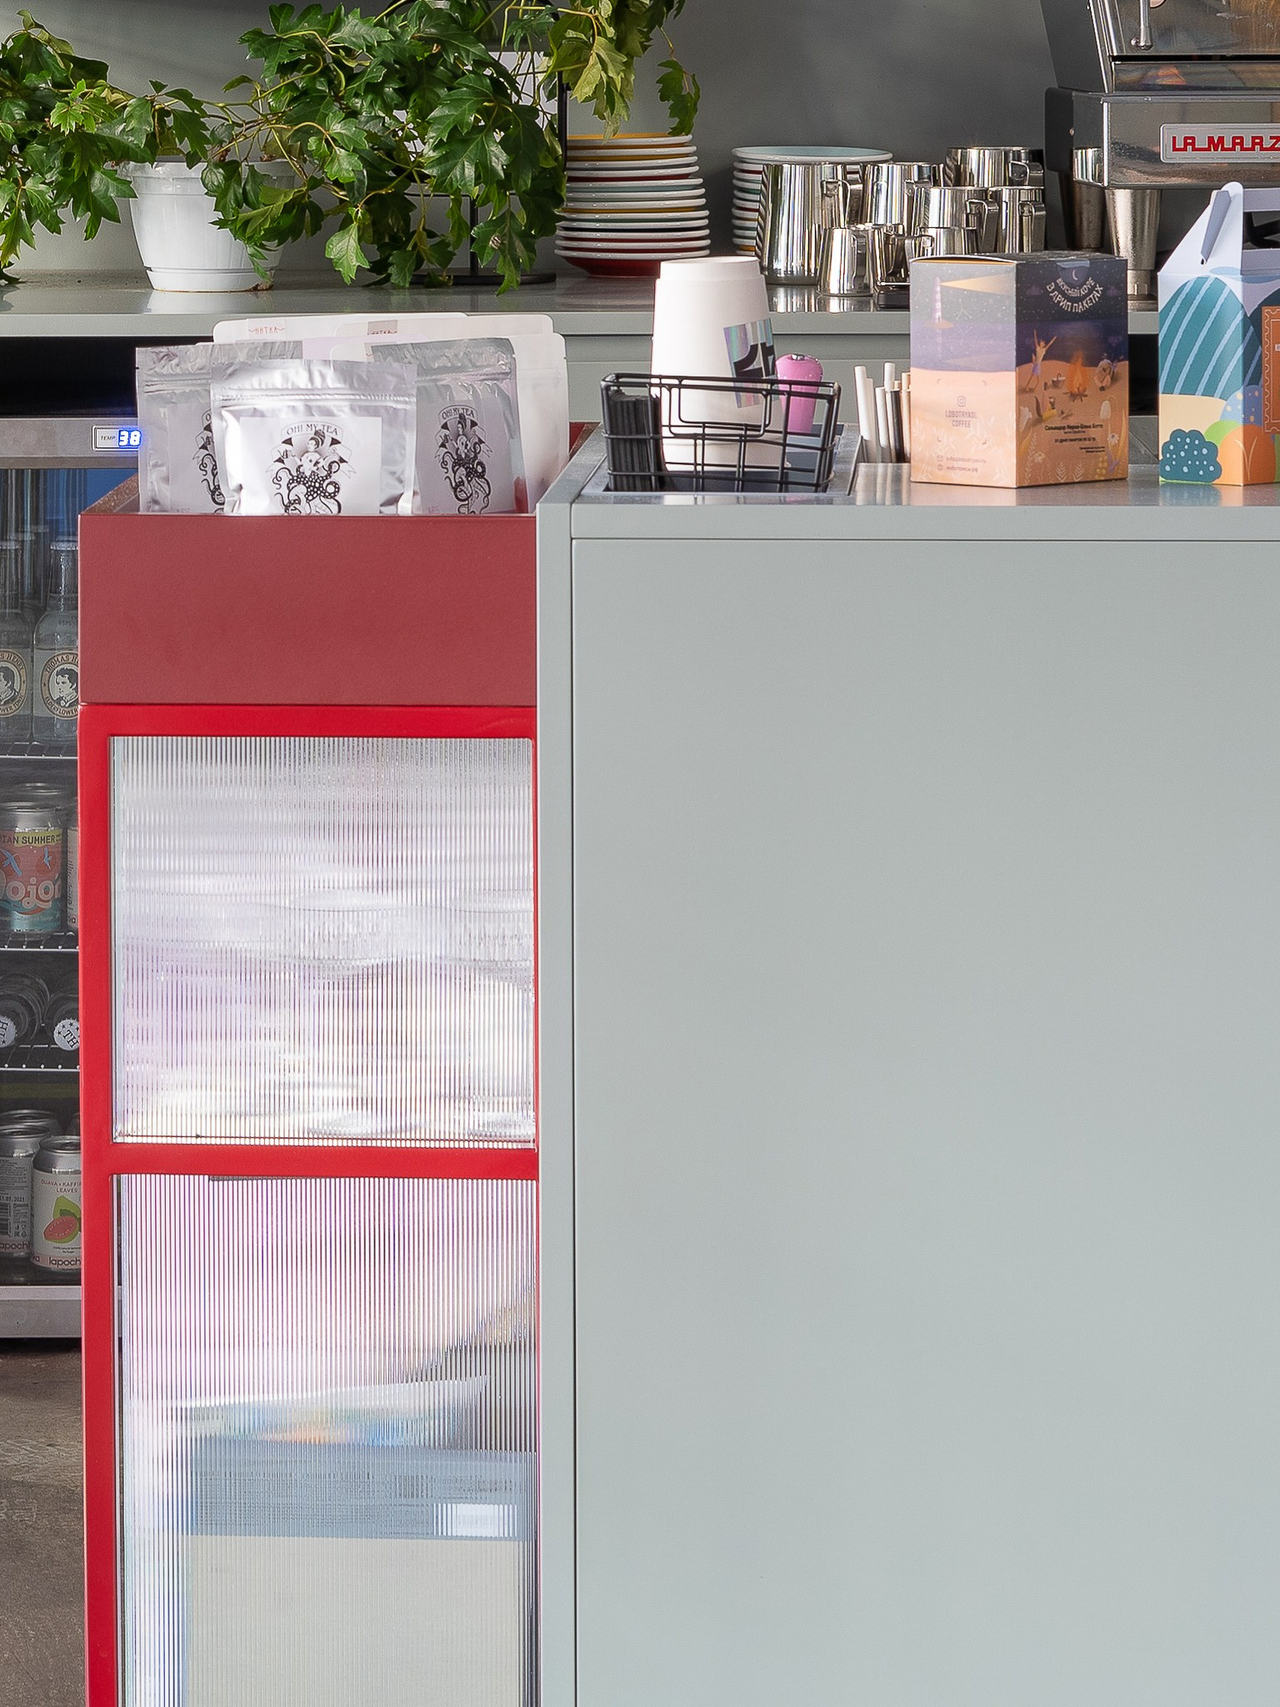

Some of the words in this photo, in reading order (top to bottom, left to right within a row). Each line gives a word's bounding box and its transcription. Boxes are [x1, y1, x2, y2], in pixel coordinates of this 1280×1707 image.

[1172, 135, 1196, 152] LA
[1046, 282, 1055, 292] В
[1049, 290, 1072, 312] ДРИП
[1072, 283, 1104, 313] ПАКЕТАХ
[286, 424, 303, 435] OH!
[306, 423, 319, 432] MY
[321, 424, 338, 436] TEA
[951, 419, 971, 428] COFFEE
[119, 430, 141, 446] 38
[6, 653, 24, 671] HENRY
[45, 654, 70, 673] THOMAS
[63, 1029, 79, 1048] TH
